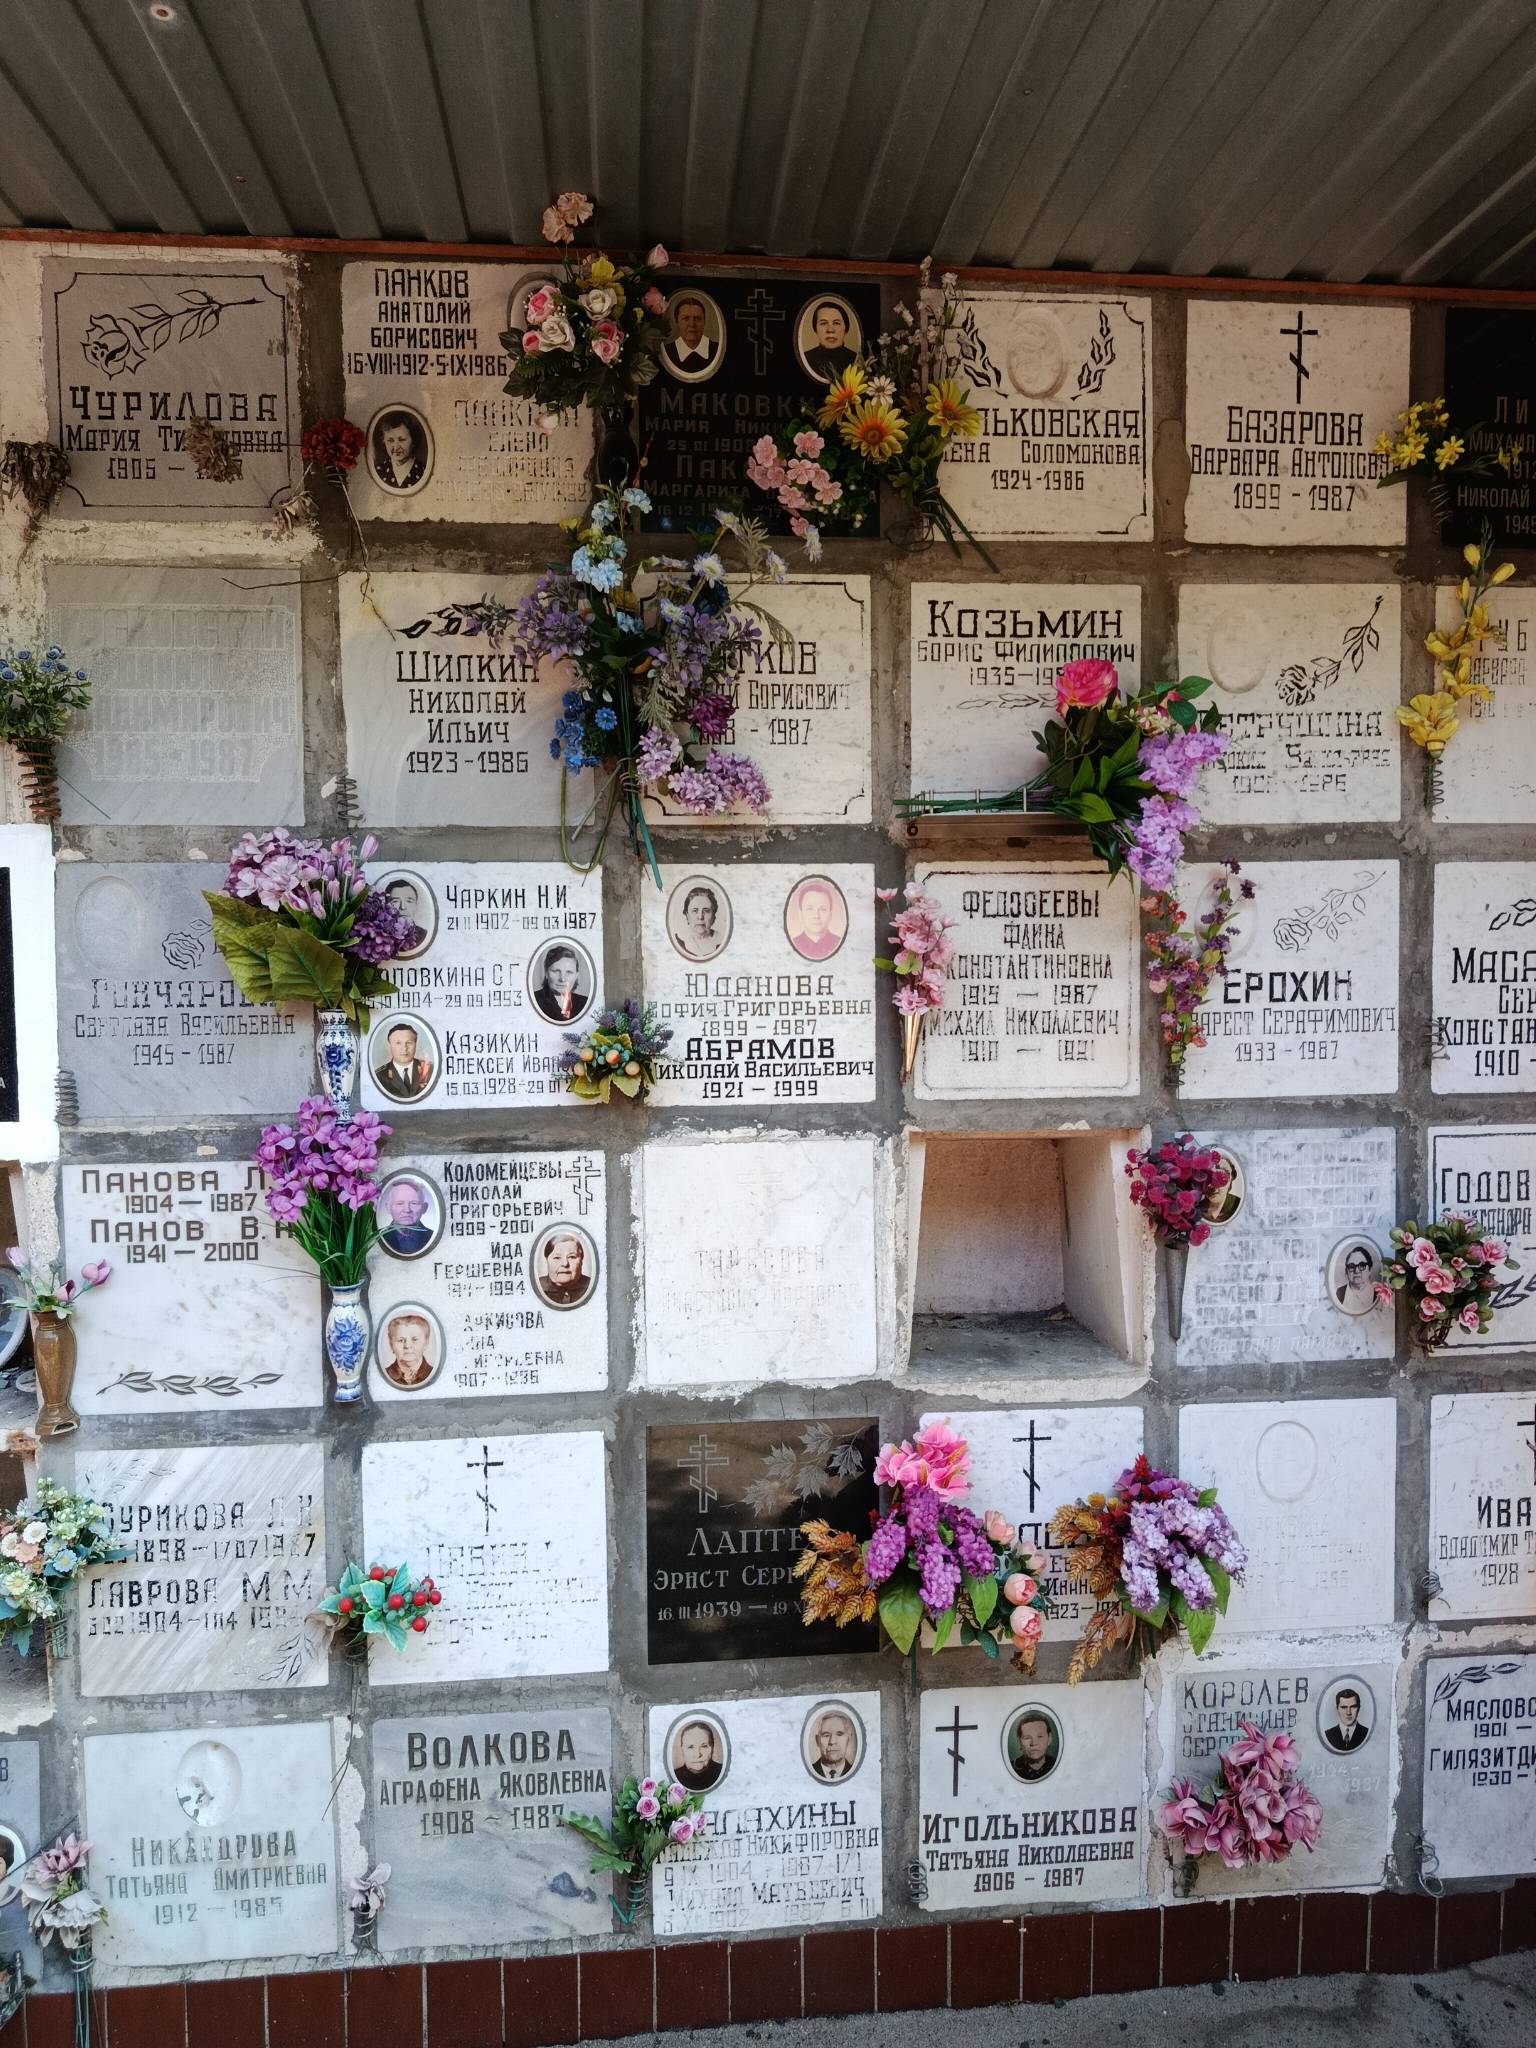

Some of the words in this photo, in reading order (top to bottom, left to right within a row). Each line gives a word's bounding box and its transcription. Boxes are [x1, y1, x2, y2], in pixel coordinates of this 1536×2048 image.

[375, 269, 468, 298] ПАНКОВ
[379, 300, 470, 324] АНАТОЛИЙ
[371, 327, 477, 350] БОРИСОВИЧ
[69, 386, 277, 421] ЧУРИЛОВА
[66, 425, 140, 451] МАРИЯ
[1226, 406, 1364, 446] БАЗАРОВА
[107, 458, 156, 479] 1905
[1190, 444, 1280, 477] ВАРВАРА
[1457, 483, 1531, 507] НИКОЛАЙ
[927, 600, 1124, 638] КОЗЬМИН
[917, 641, 983, 662] БОРИС
[995, 640, 1135, 663] ФИЛИППОВИЧ
[395, 650, 540, 682] ШИПКИН
[409, 687, 527, 714] НИКОЛАЙ
[428, 719, 510, 744] ИЛЬИЧ
[446, 884, 526, 909] ЧАРКИН
[962, 890, 1100, 919] ФЕДОСЕЕВЫ
[1003, 921, 1066, 950] ФАИНА
[684, 972, 835, 998] ЮДАНОВА
[1222, 969, 1352, 1004] ЕРОХИН
[723, 1000, 873, 1018] ГРИГОРЬЕВНА
[1005, 1007, 1120, 1035] НИКОЛАЕВИЧ
[1263, 1007, 1395, 1034] СЕРАФИМОВИЧ
[180, 1012, 296, 1036] ВАСИЛЬЕВНА
[446, 1030, 538, 1054] КАЗИКИН
[684, 1037, 835, 1061] АБРАМОВ
[744, 1061, 874, 1079] ВАСИЛЬЕВИЧ
[82, 1169, 219, 1194] ПАНОВА
[444, 1160, 562, 1182] КОЛОМЕЙЦЕВЫ
[449, 1181, 522, 1201] НИКОЛАЙ
[449, 1200, 564, 1219] ГРИГОРЬЕВИЧ
[90, 1219, 205, 1243] ПАНОВ
[490, 1242, 524, 1260] ИДА
[87, 1577, 218, 1608] ЛАВРОВА
[652, 1568, 730, 1591] ЭРНСТ
[1183, 1677, 1310, 1709] КОРОЛЕВ
[407, 1728, 577, 1771] ВОЛКОВА
[380, 1776, 482, 1806] АГРАФЕНА
[499, 1768, 607, 1800] ЯКОВЛЕВНА
[922, 1805, 1138, 1845] ИГОЛЬНИКОВА
[131, 1830, 297, 1867] НИКАНДРОВА
[926, 1848, 1010, 1872] ТАТЬЯНА
[1017, 1840, 1135, 1867] НИКОЛАЕВНА
[105, 1872, 188, 1899] ТАТЬЯНА
[213, 1862, 328, 1891] ДМИТРИЕВНА
[973, 1871, 1015, 1893] 1906
[1043, 1867, 1085, 1888] 1987
